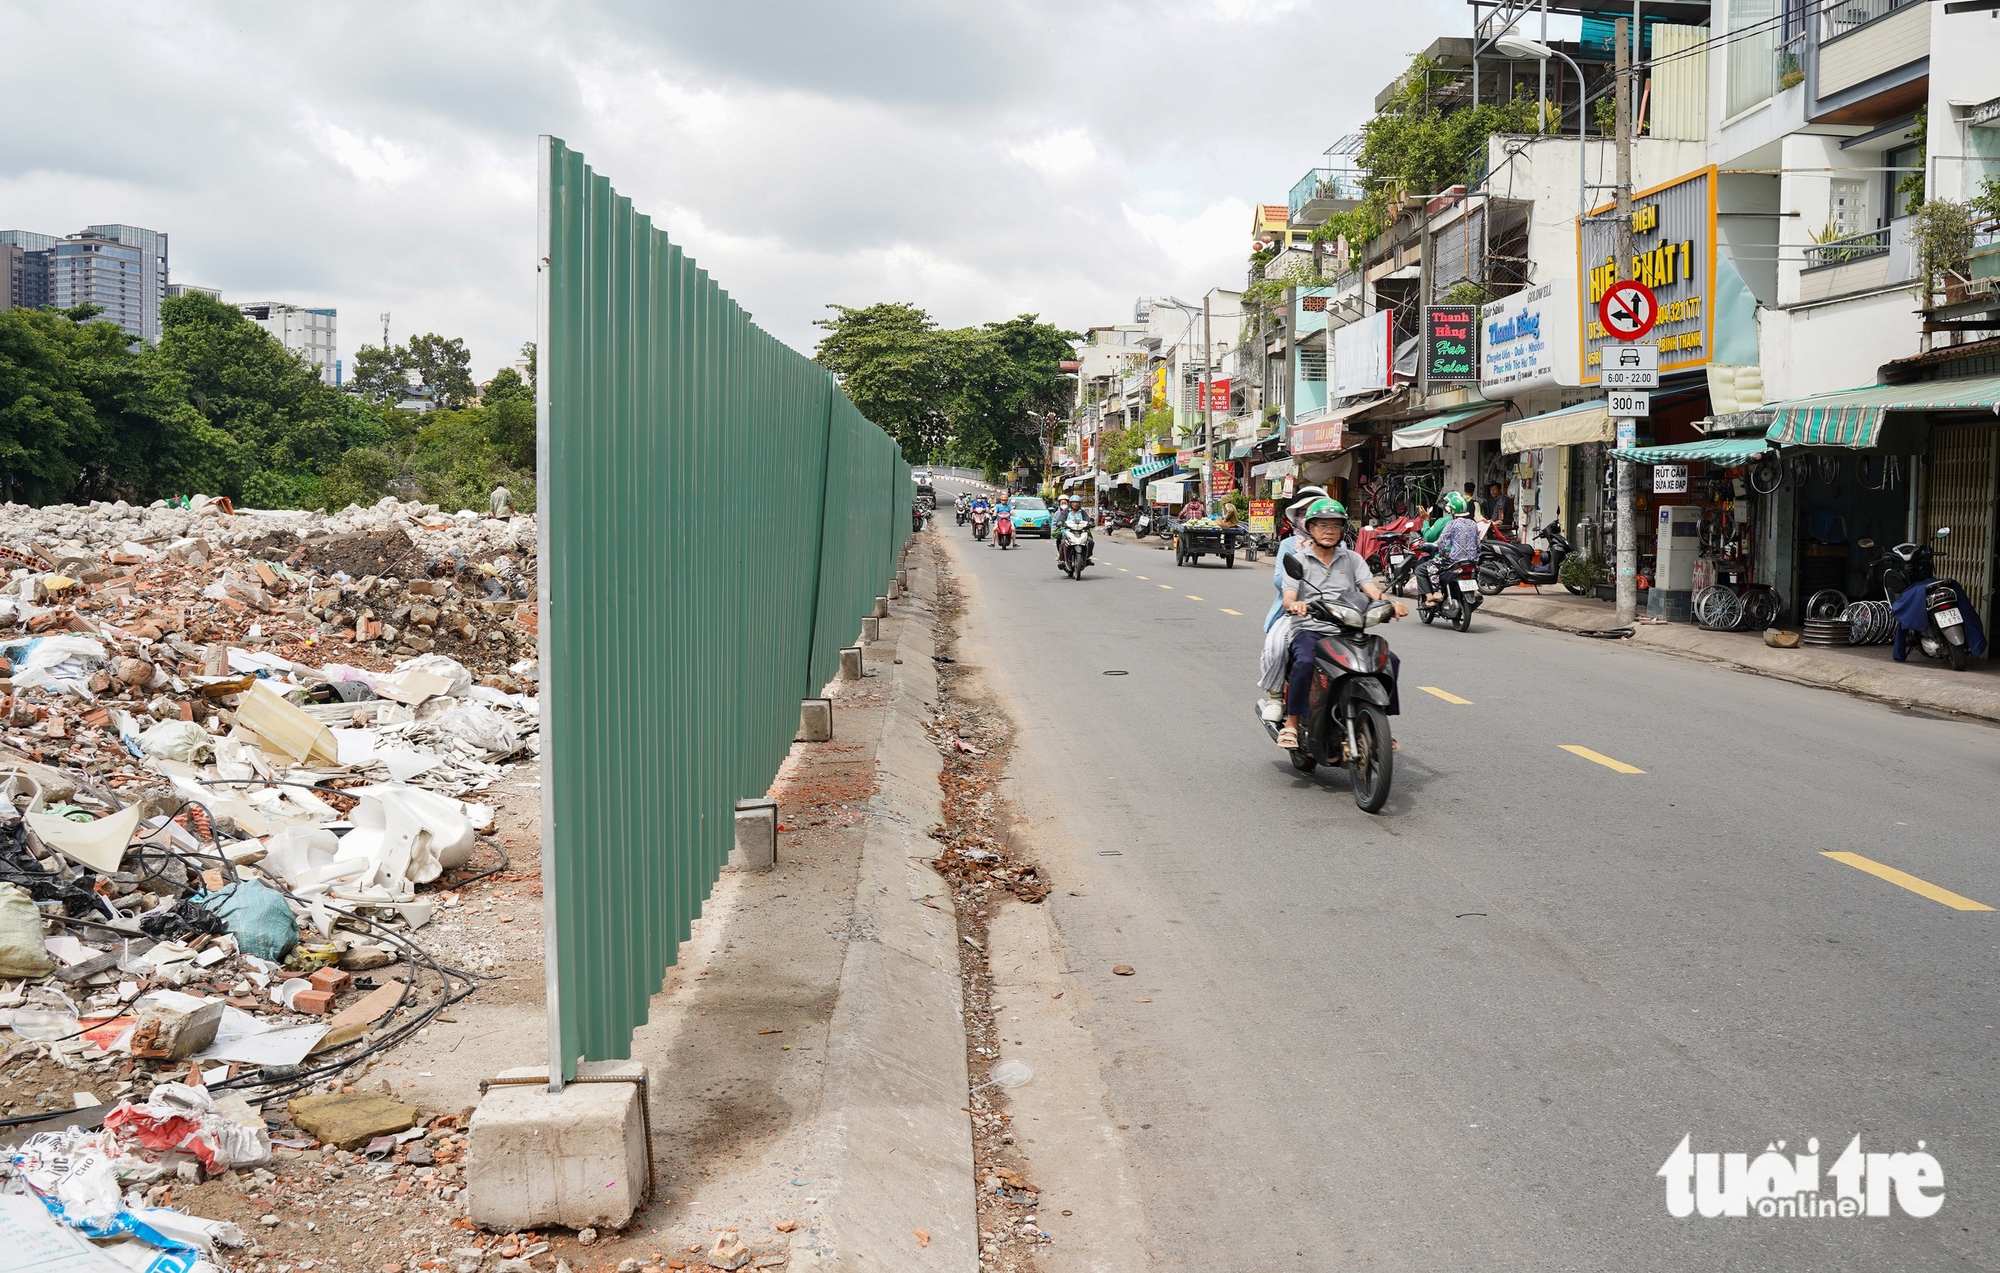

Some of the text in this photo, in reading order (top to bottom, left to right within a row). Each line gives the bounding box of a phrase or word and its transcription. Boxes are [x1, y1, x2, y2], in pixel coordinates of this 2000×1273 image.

[1632, 239, 1676, 288] PHÁT
[1681, 240, 1691, 279] 1
[1527, 284, 1552, 303] GOLDWELL
[1432, 312, 1470, 322] Thanh
[1489, 317, 1515, 346] Thanh
[1436, 340, 1466, 355] Hair
[1679, 331, 1702, 352] THẠNH
[1433, 359, 1469, 373] Salon
[1608, 373, 1624, 383] 6:00
[1631, 373, 1651, 383] 22:00
[1612, 397, 1632, 410] 300
[1635, 400, 1645, 410] m
[1655, 466, 1669, 478] RÚT
[1655, 479, 1686, 491] SỬA XE ĐẠP
[75, 1157, 95, 1177] CHO
